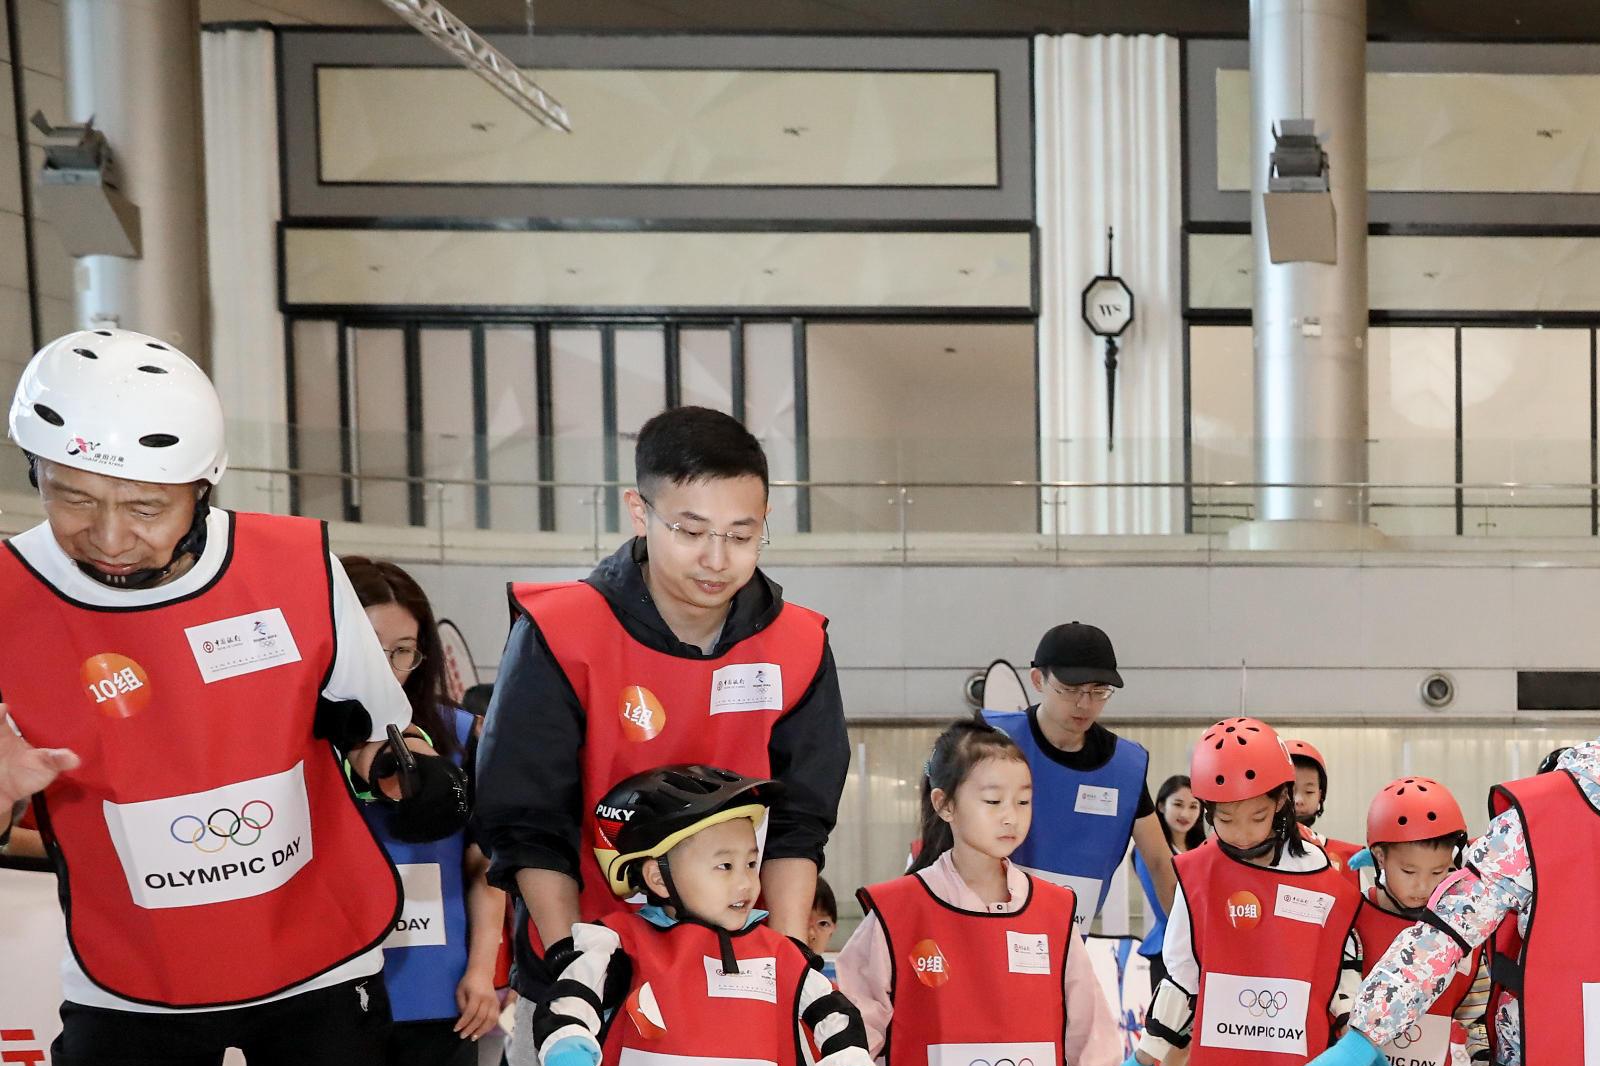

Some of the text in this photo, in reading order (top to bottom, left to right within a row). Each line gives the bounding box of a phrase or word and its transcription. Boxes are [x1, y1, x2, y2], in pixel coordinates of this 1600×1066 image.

[89, 667, 144, 703] 10组
[596, 804, 635, 822] PUKY
[145, 836, 302, 889] OLYMPIC DAY
[1229, 904, 1258, 918] 10组
[395, 918, 430, 931] DAY
[917, 956, 944, 973] 9组
[1217, 1022, 1304, 1040] OLYMPIC DAY
